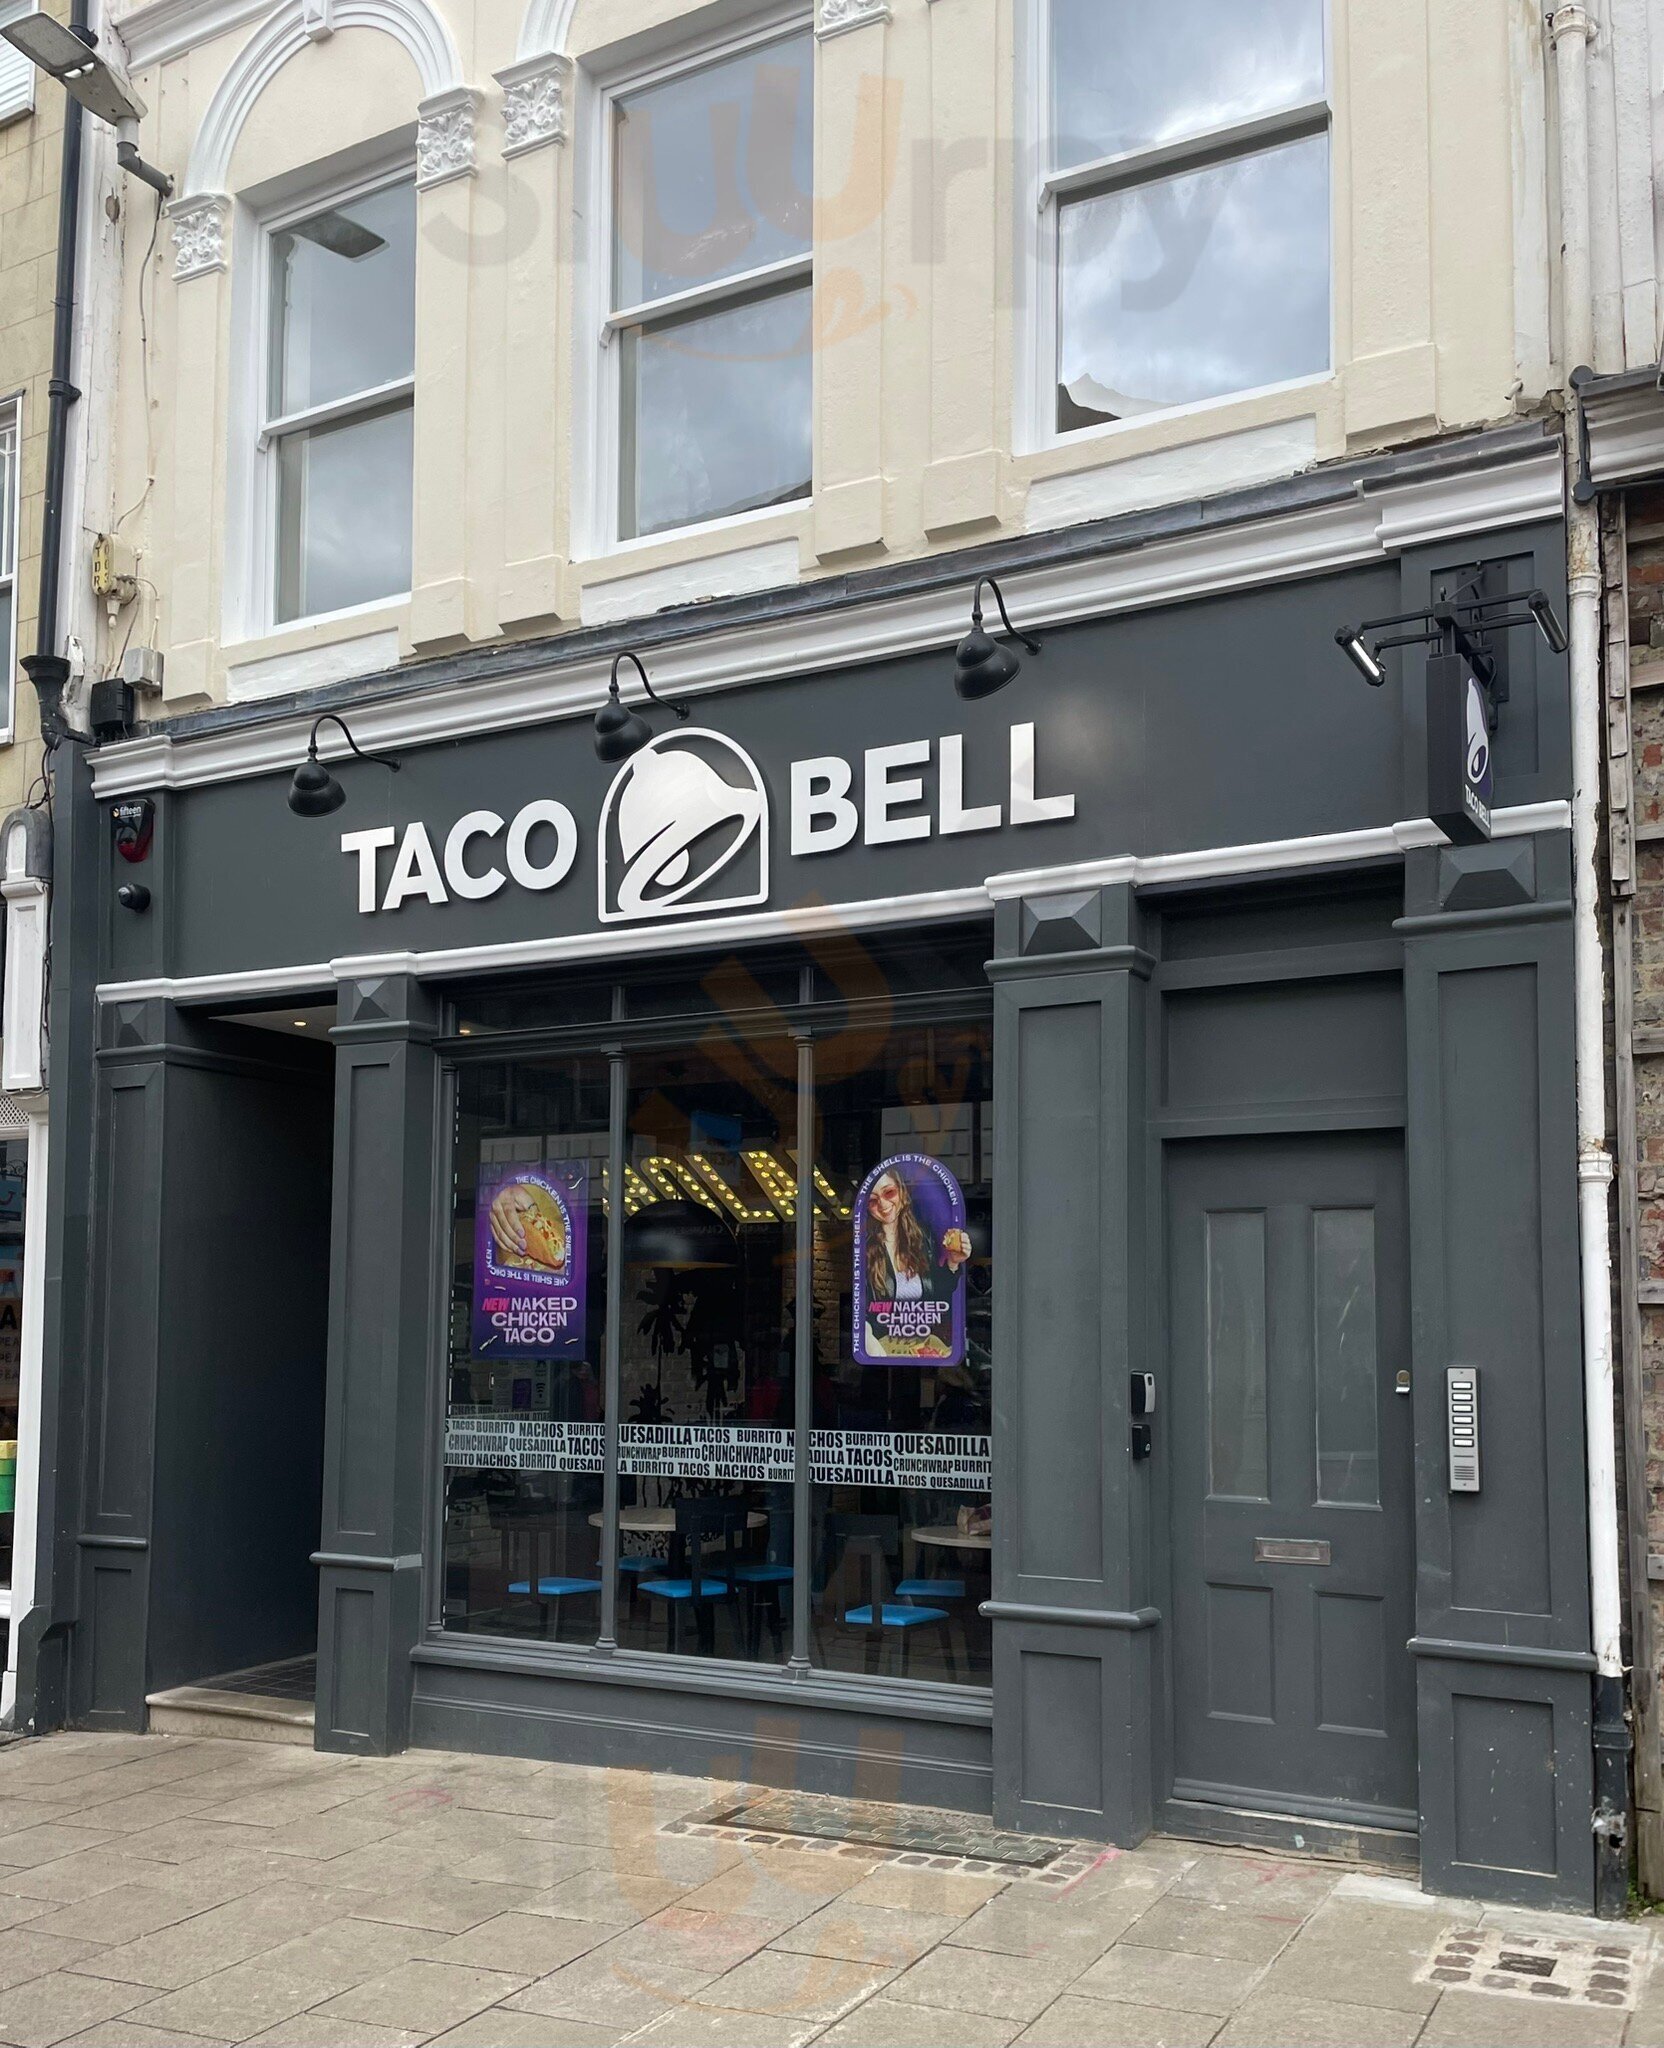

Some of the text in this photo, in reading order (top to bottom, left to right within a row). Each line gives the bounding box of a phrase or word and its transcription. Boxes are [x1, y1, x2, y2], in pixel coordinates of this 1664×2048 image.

[1465, 784, 1478, 814] TACO
[340, 721, 1076, 914] TACO BELL
[530, 1176, 562, 1205] CHICKEN
[860, 1176, 873, 1194] THE
[872, 1156, 901, 1176] SHELL
[912, 1155, 933, 1166] THE
[932, 1164, 959, 1206] CHICKEN
[482, 1297, 577, 1311] NEW NAKED
[868, 1301, 950, 1313] NEW NAKED
[876, 1313, 942, 1324] CHICKEN
[491, 1312, 567, 1327] CHICKEN
[887, 1324, 931, 1336] TACO
[503, 1328, 555, 1343] TACO
[452, 1420, 475, 1431] TACOS
[476, 1421, 515, 1433] BURRITO
[519, 1422, 563, 1438] NACHOS
[567, 1424, 605, 1436] BURRITO
[619, 1425, 692, 1445] UESADILLA
[693, 1428, 730, 1444] TACOS
[737, 1429, 782, 1444] BURRITO
[846, 1433, 890, 1446] BURRITO
[894, 1435, 989, 1457] QUESADILLA
[449, 1434, 508, 1452] CRUNCHWRAP
[509, 1437, 566, 1453] QUESADILLA
[567, 1437, 605, 1456] TACOS
[617, 1446, 661, 1460] RUNCHWRAP
[662, 1447, 700, 1460] BURRITO
[702, 1444, 772, 1464] CRUNCHWRAP
[846, 1449, 893, 1467] TACOS
[893, 1458, 953, 1473] CRUNCHWRAP
[954, 1460, 991, 1473] BURRIT
[476, 1453, 517, 1467] NACHOS
[519, 1454, 556, 1469] BURRITO
[632, 1461, 673, 1474] BURRITO
[678, 1462, 710, 1477] TACOS
[715, 1464, 764, 1479] NACHOS
[808, 1467, 895, 1485] QUESADILLA
[897, 1474, 926, 1486] TACOS
[930, 1476, 984, 1490] QUESADILLA
